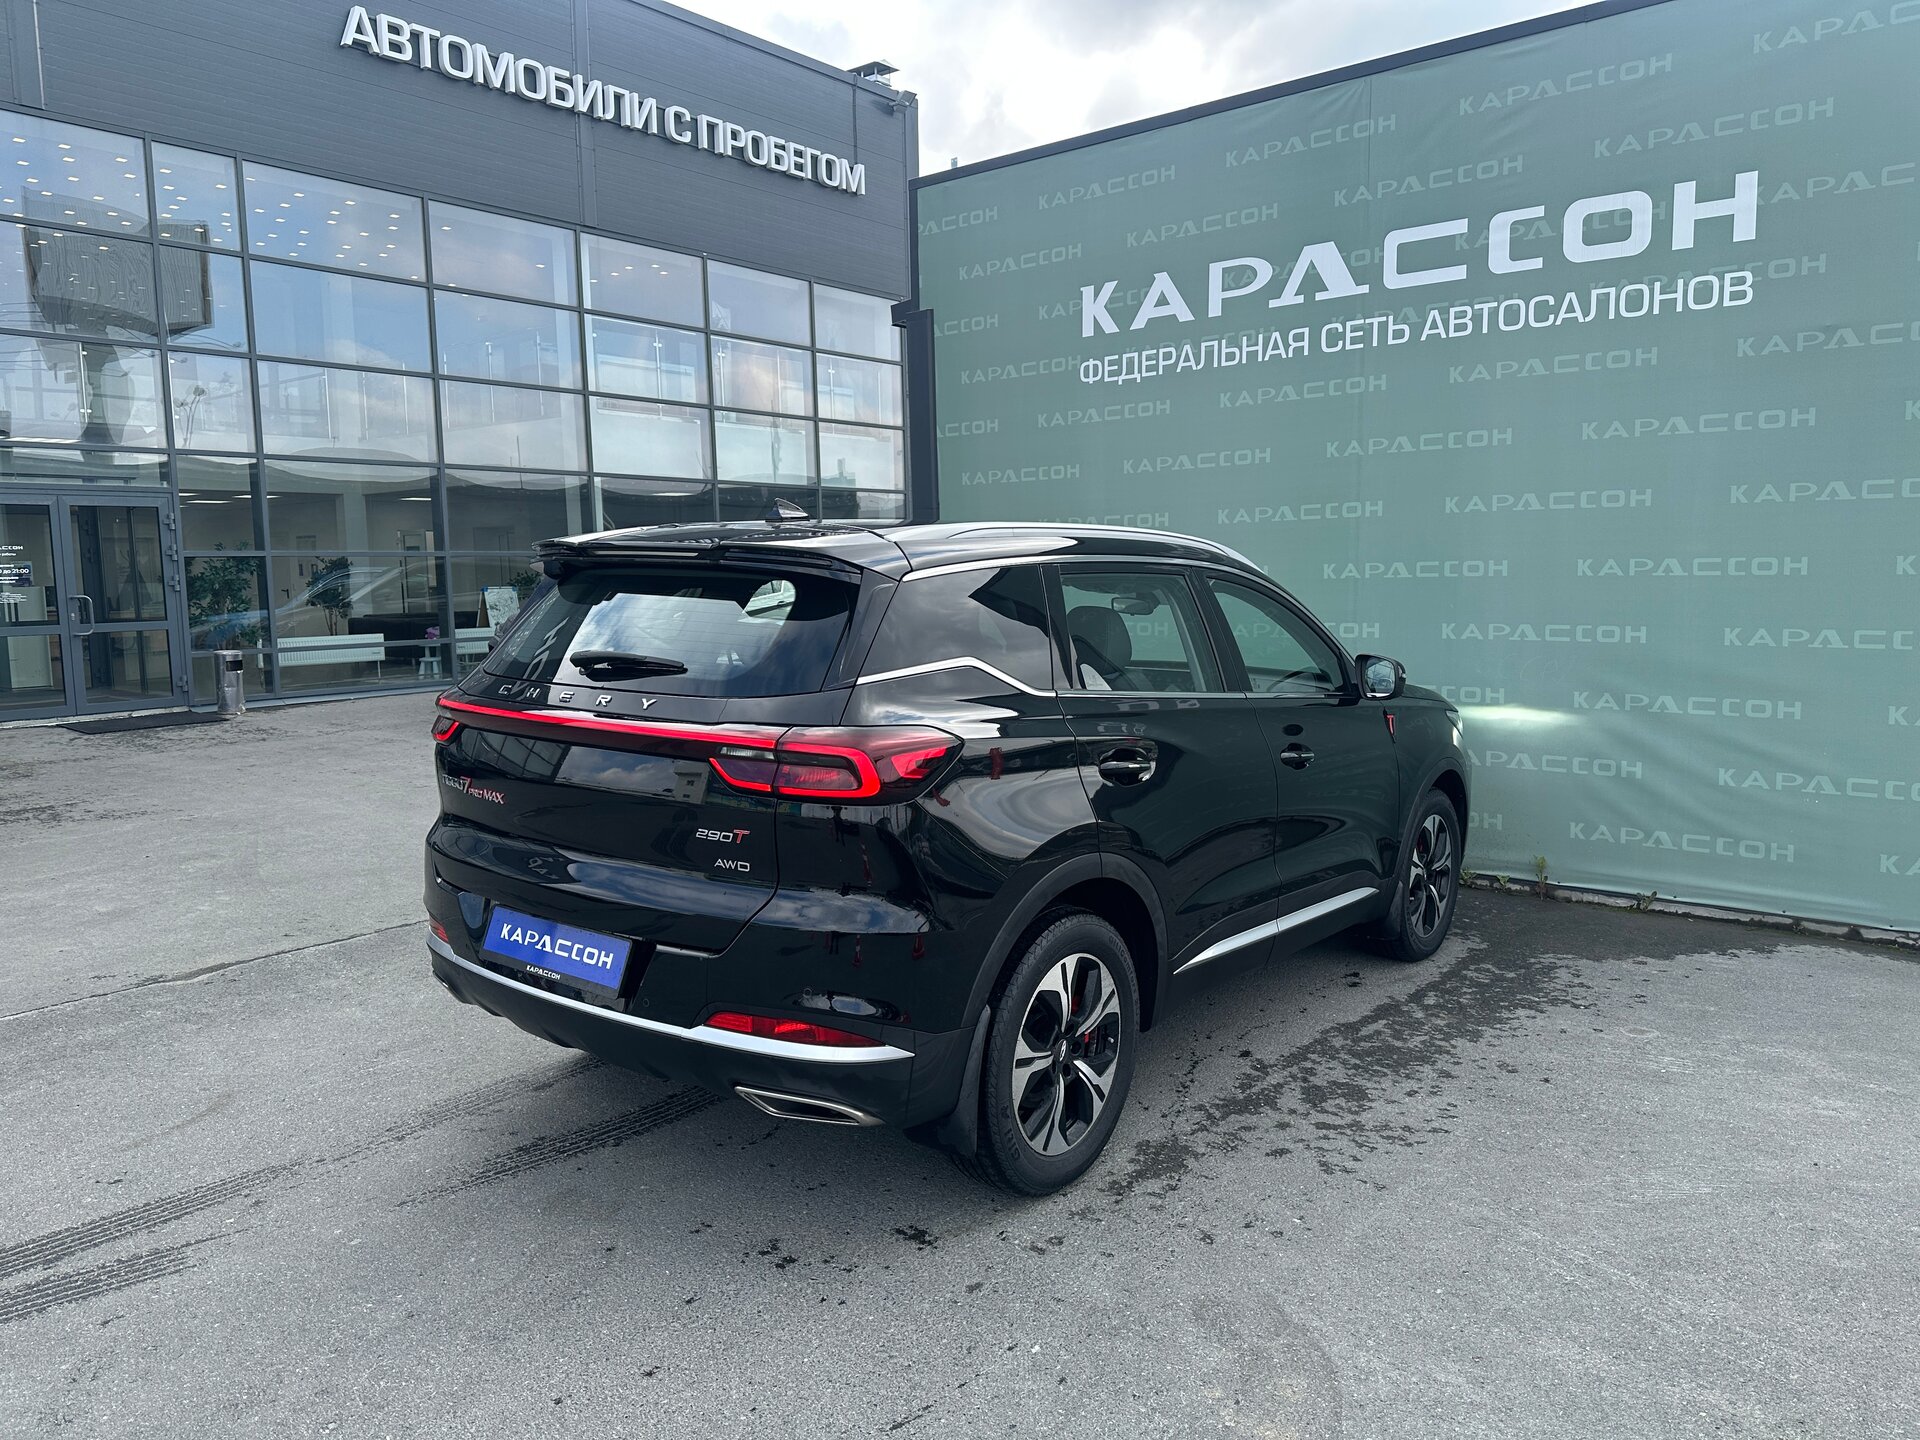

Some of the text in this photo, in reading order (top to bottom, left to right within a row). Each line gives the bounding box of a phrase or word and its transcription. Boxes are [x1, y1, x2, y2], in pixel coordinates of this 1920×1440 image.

[340, 5, 866, 196] АВТОМОБИЛИ С ПРОБЕГОМ
[1459, 52, 1673, 117] КАРАССОН
[1225, 114, 1396, 168] КАРАССОН
[1594, 97, 1835, 159] КАРАССОН
[1038, 165, 1176, 211] КАРАССОН
[1333, 154, 1523, 207] КАРАССОН
[1126, 203, 1279, 248] КАРАССОН
[958, 243, 1082, 281] КАРАССОН
[1080, 170, 1758, 338] КАРАССОН
[1079, 271, 1754, 385] ФЕДЕРАЛЬНАЯ СЕТЬ АВТОСАЛОНОВ
[1448, 346, 1659, 384] КАРАССОН
[1219, 374, 1388, 409] КАРАССОН
[1037, 399, 1171, 429] КАРАССОН
[1580, 407, 1817, 441] КАРАССОН
[1325, 427, 1513, 459] КАРАССОН
[960, 464, 1080, 486] КАРАССОН
[1122, 447, 1272, 475] КАРАССОН
[1217, 500, 1384, 525] КАРАССОН
[1444, 488, 1653, 514] КАРАССОН
[1322, 558, 1508, 580] КАРАССОН
[1576, 556, 1808, 577] КАРАССОН
[1441, 622, 1648, 644] КАРАССОН
[498, 684, 657, 710] CHERY
[1573, 690, 1802, 721] КАРАССОН
[695, 828, 751, 844] 290T
[1568, 821, 1796, 863] КАРАССОН
[713, 858, 751, 872] AWD
[500, 923, 614, 970] КАРАССОН
